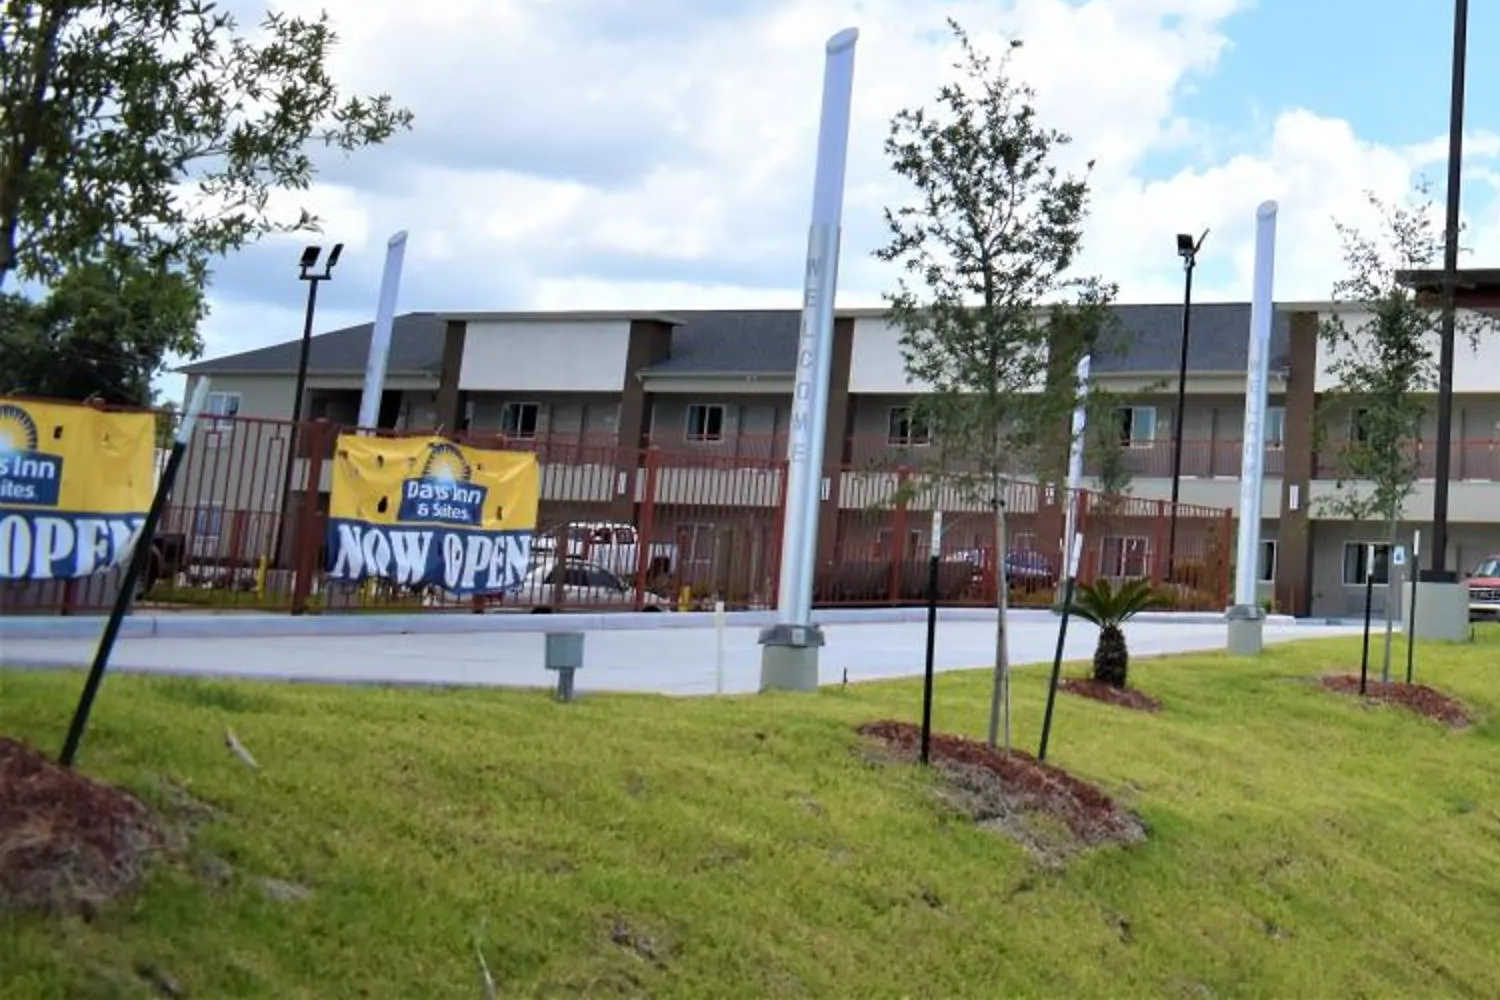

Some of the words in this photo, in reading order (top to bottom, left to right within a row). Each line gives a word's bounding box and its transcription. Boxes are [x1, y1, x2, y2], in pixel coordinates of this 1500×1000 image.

[791, 256, 823, 463] WELCOME
[12, 455, 56, 479] Inn
[0, 479, 36, 499] ites
[453, 484, 482, 505] Inn
[417, 502, 429, 517] &
[432, 502, 470, 520] Sites
[329, 523, 434, 585] NOW
[443, 532, 532, 588] OPEN
